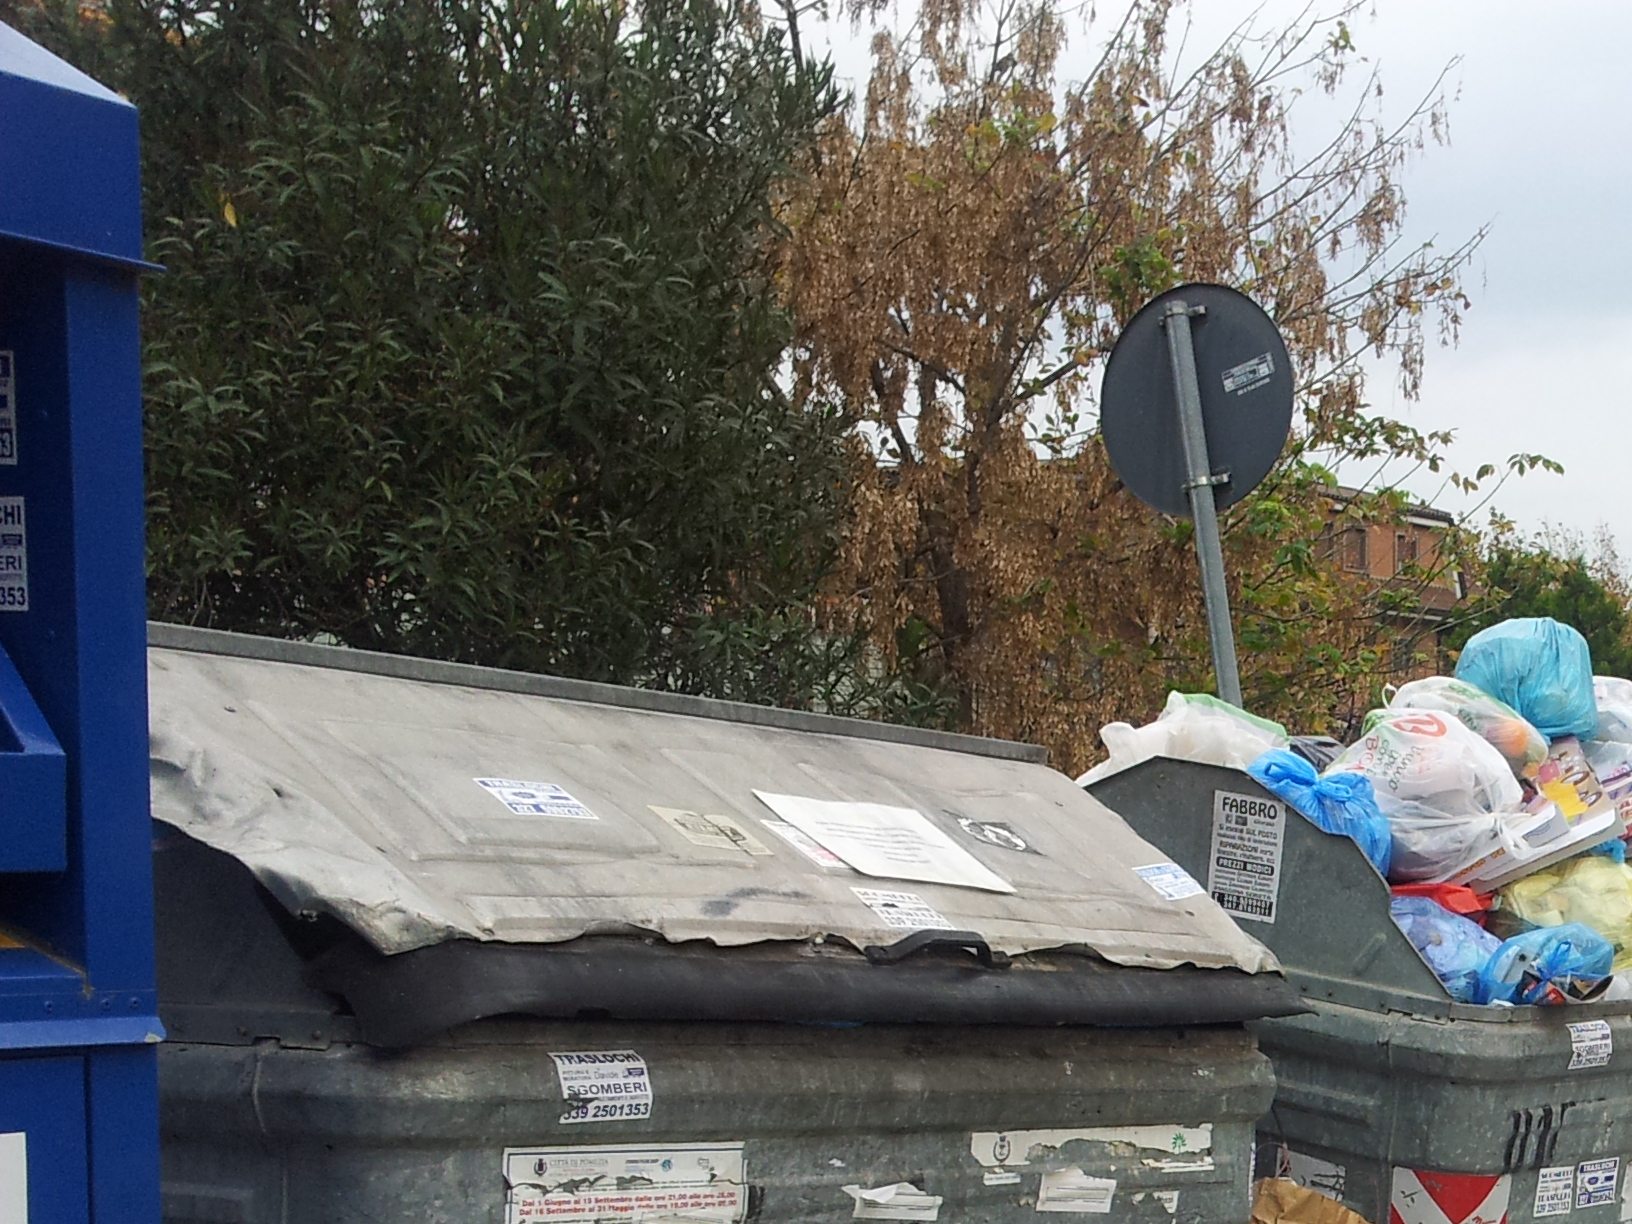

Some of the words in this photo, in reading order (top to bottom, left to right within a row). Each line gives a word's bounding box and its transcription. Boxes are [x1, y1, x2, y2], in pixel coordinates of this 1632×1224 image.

[1222, 796, 1278, 820] FABBRO
[1218, 857, 1244, 869] PREZZI
[1246, 864, 1272, 875] MODICI
[554, 1053, 640, 1065] TRASLOCHI
[567, 1081, 648, 1096] SGOMBERI
[592, 1103, 650, 1118] 2501353
[546, 1206, 586, 1214] Settembre
